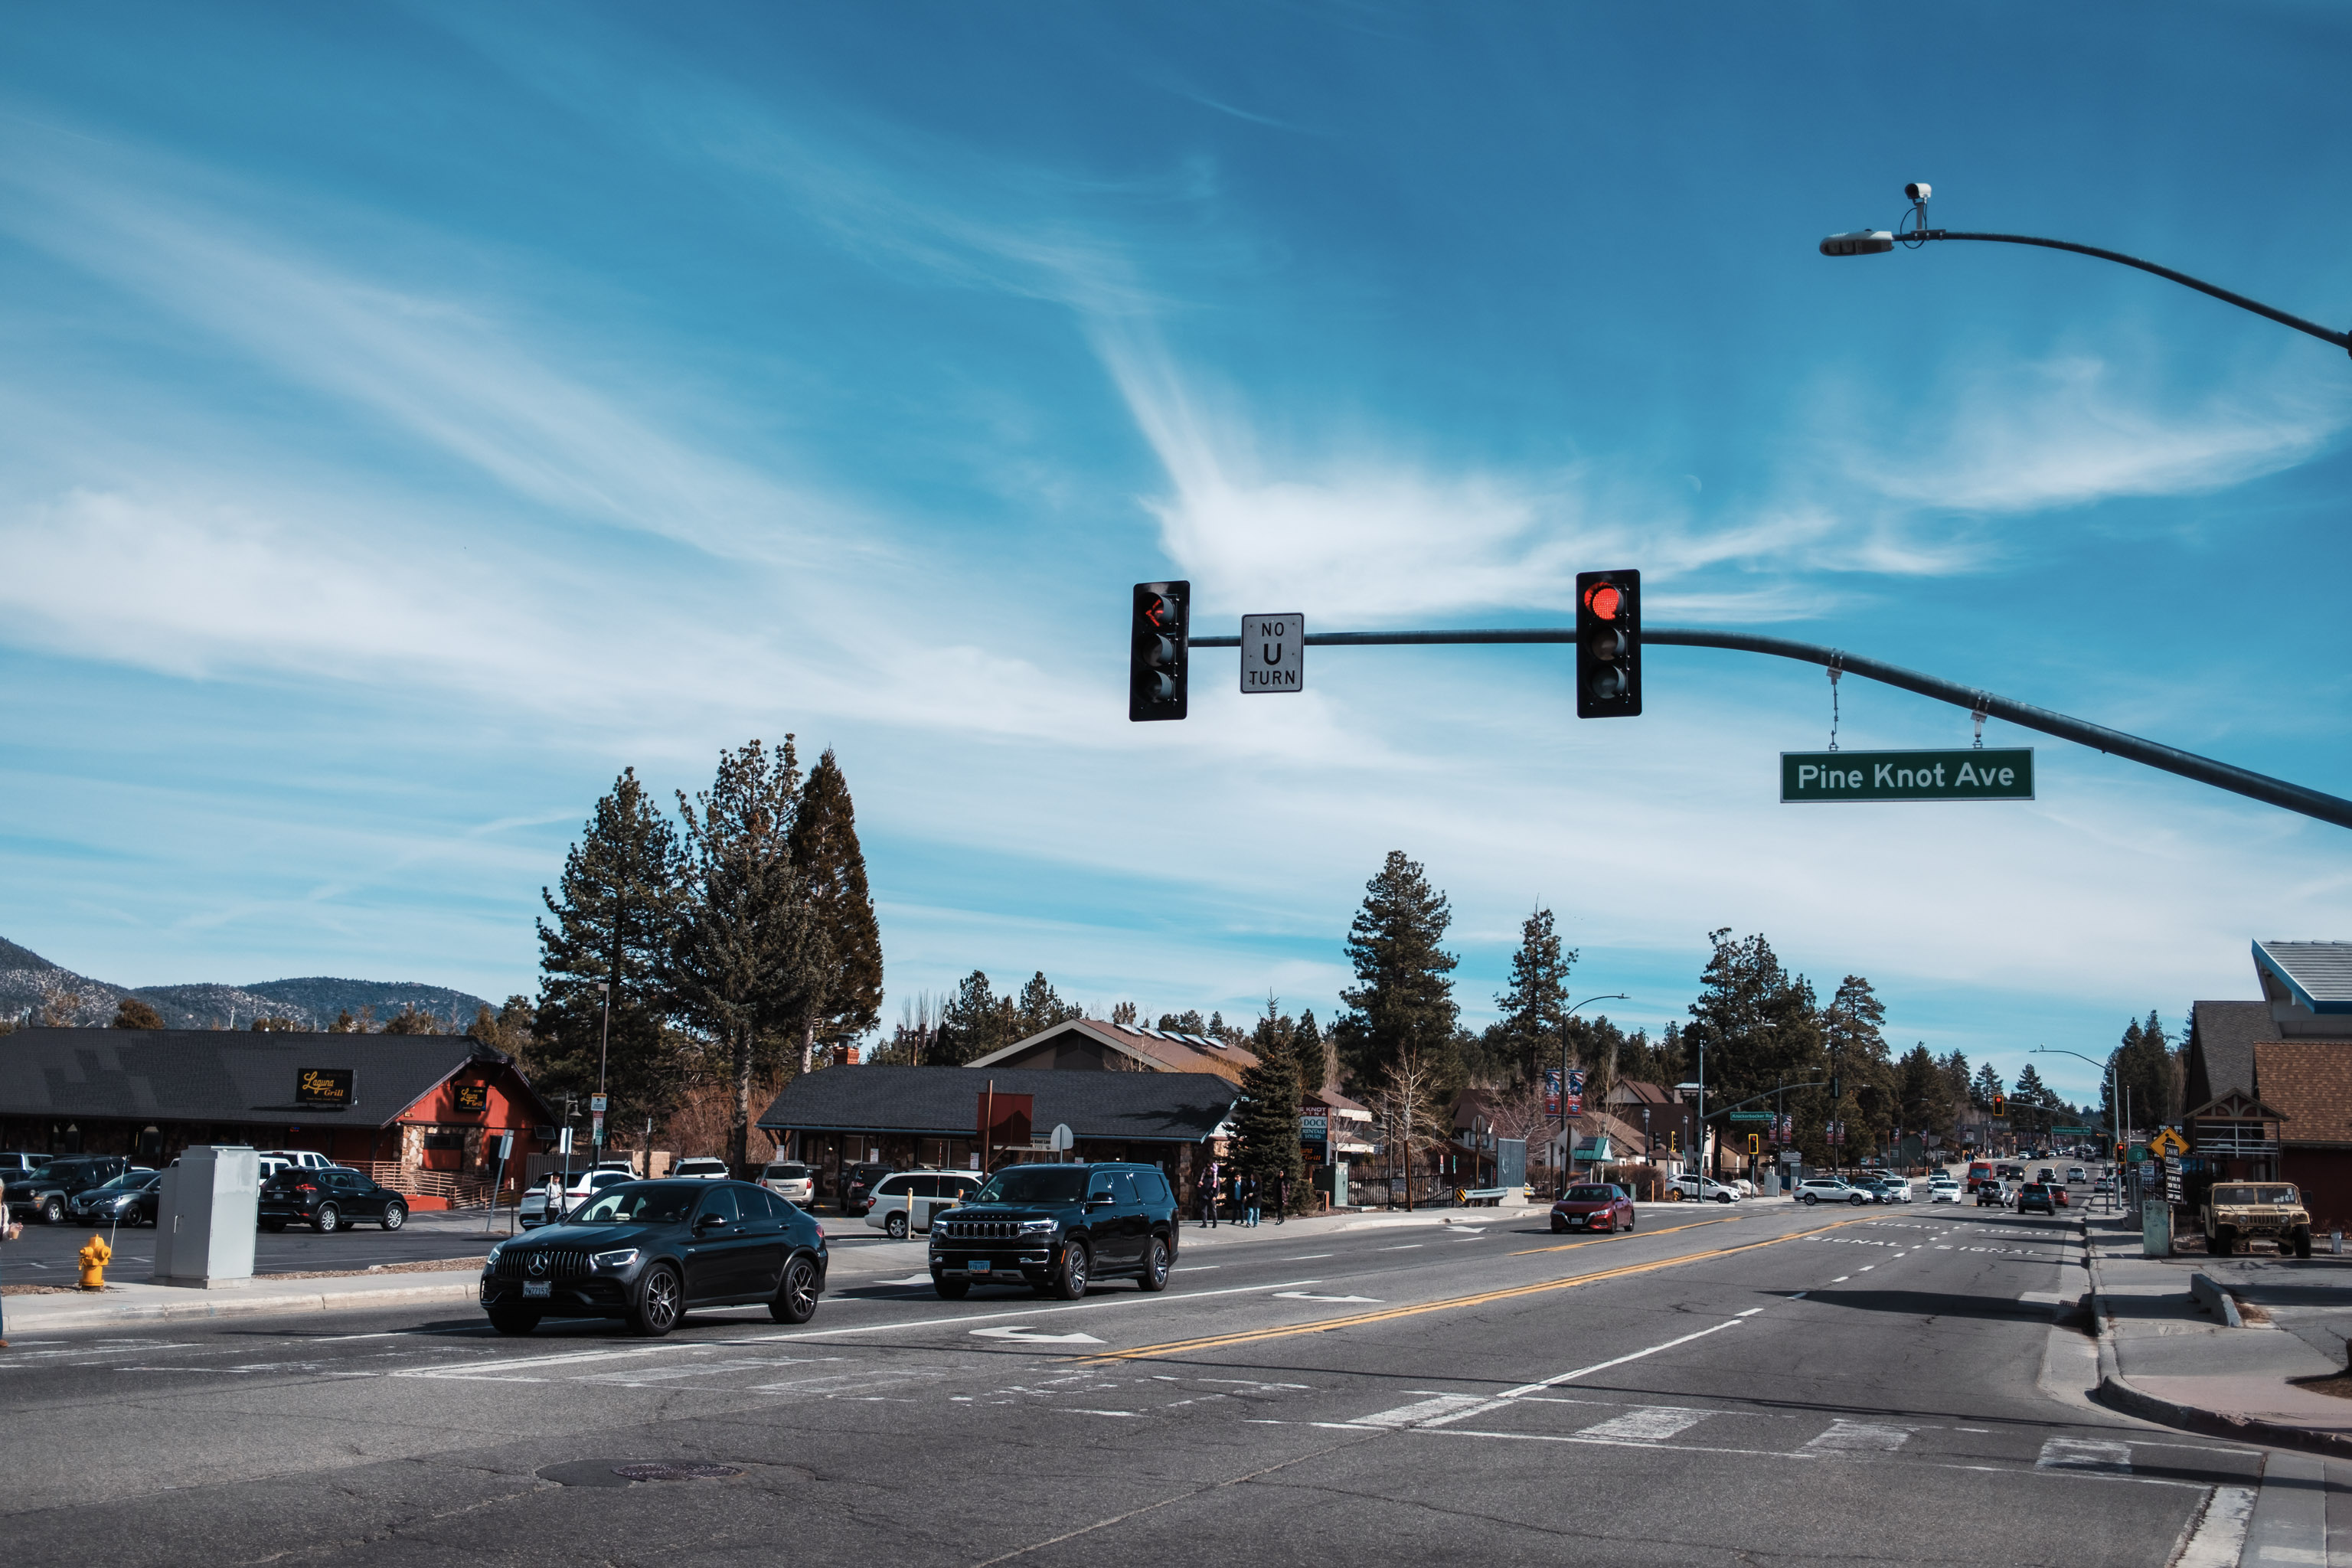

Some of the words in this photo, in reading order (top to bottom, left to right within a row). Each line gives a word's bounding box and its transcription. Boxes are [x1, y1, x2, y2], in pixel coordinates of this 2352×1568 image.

[1262, 622, 1285, 637] NO
[1263, 643, 1282, 665] U
[1249, 670, 1295, 685] TURN
[1798, 764, 1864, 789] Pine
[1874, 763, 1946, 789] Knot
[1954, 762, 2015, 787] Ave
[302, 1070, 335, 1095] Laguna
[2166, 1147, 2178, 1156] CHAINS
[2165, 1156, 2179, 1165] REQUIRED
[1803, 1236, 1903, 1247] SIGNAL
[1933, 1245, 2042, 1256] SIGNAL
